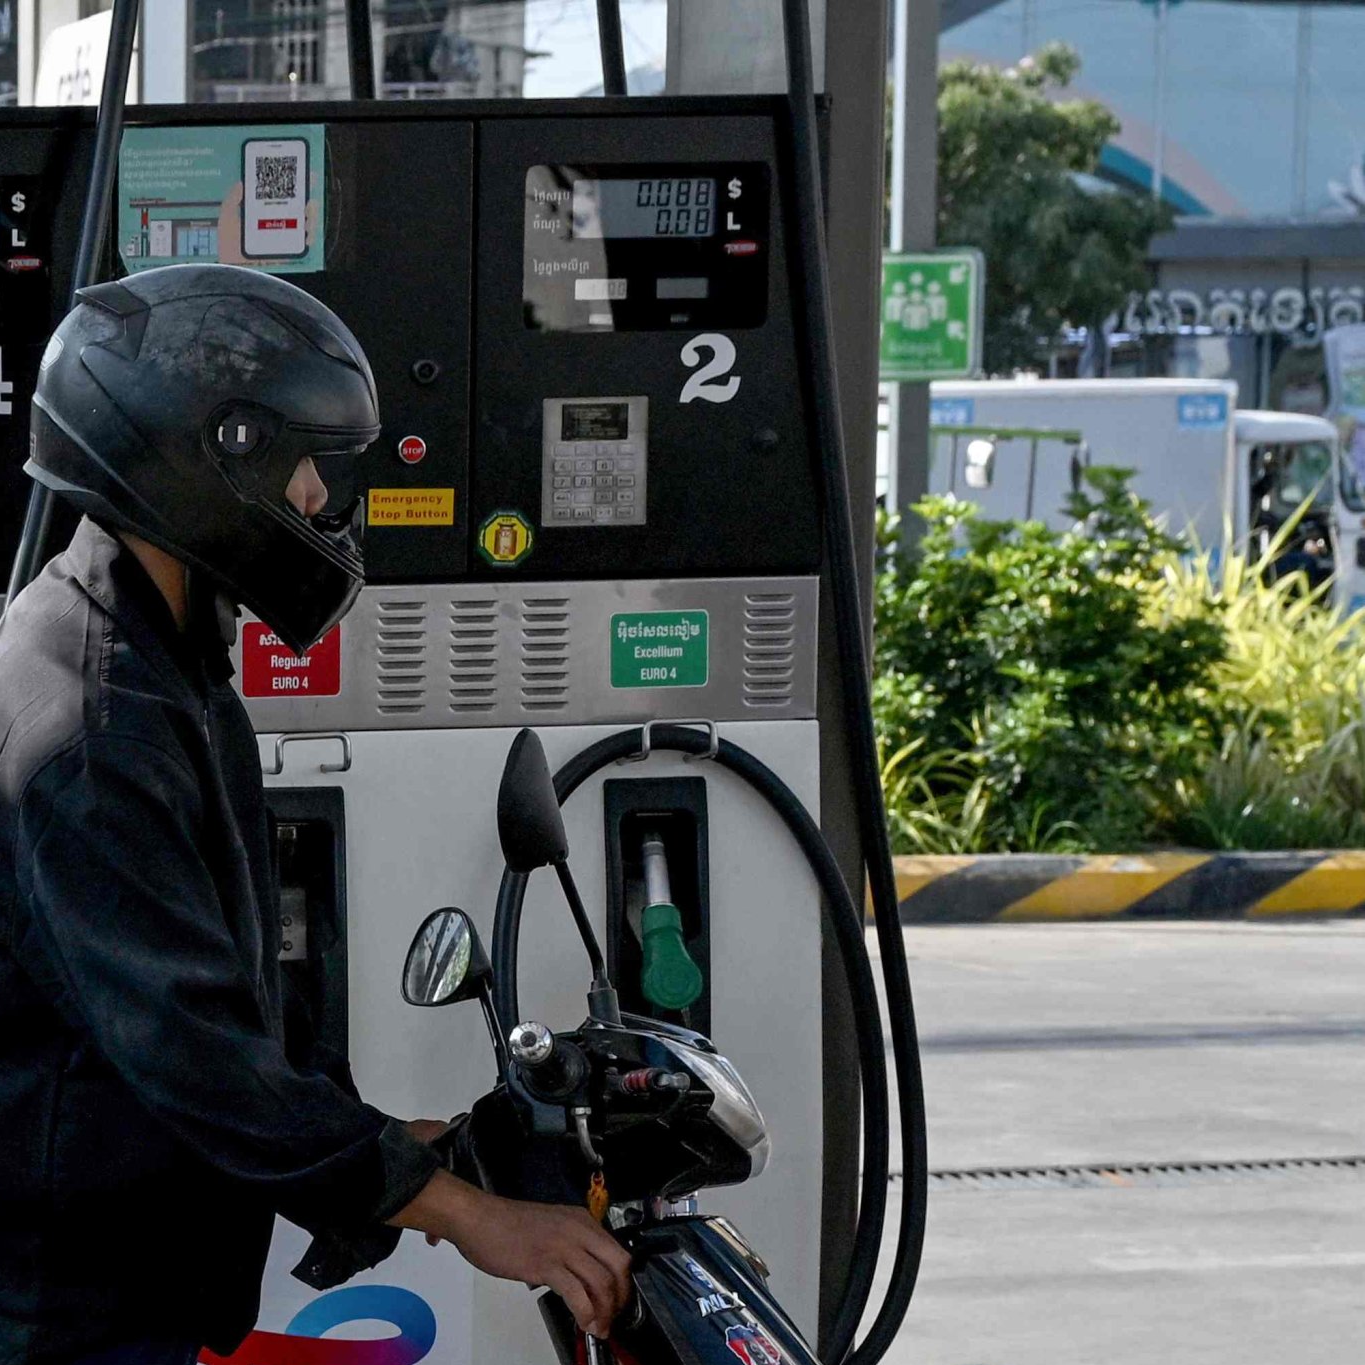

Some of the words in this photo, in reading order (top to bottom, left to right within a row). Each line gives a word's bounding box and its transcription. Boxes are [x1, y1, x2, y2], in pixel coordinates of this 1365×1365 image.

[636, 180, 711, 207] 0.088
[727, 177, 743, 200] $
[11, 191, 26, 213] $
[655, 208, 711, 235] 0.08
[727, 212, 741, 230] L
[11, 229, 26, 247] L
[678, 333, 741, 404] 2
[402, 447, 423, 456] STOP
[372, 494, 443, 505] Emergency
[372, 510, 401, 520] Stop
[406, 509, 448, 519] Button
[634, 645, 684, 659] Excellium
[270, 654, 311, 670] Regular
[640, 667, 668, 681] EURO
[669, 667, 677, 679] 4
[272, 677, 300, 690] EURO
[301, 676, 309, 689] 4
